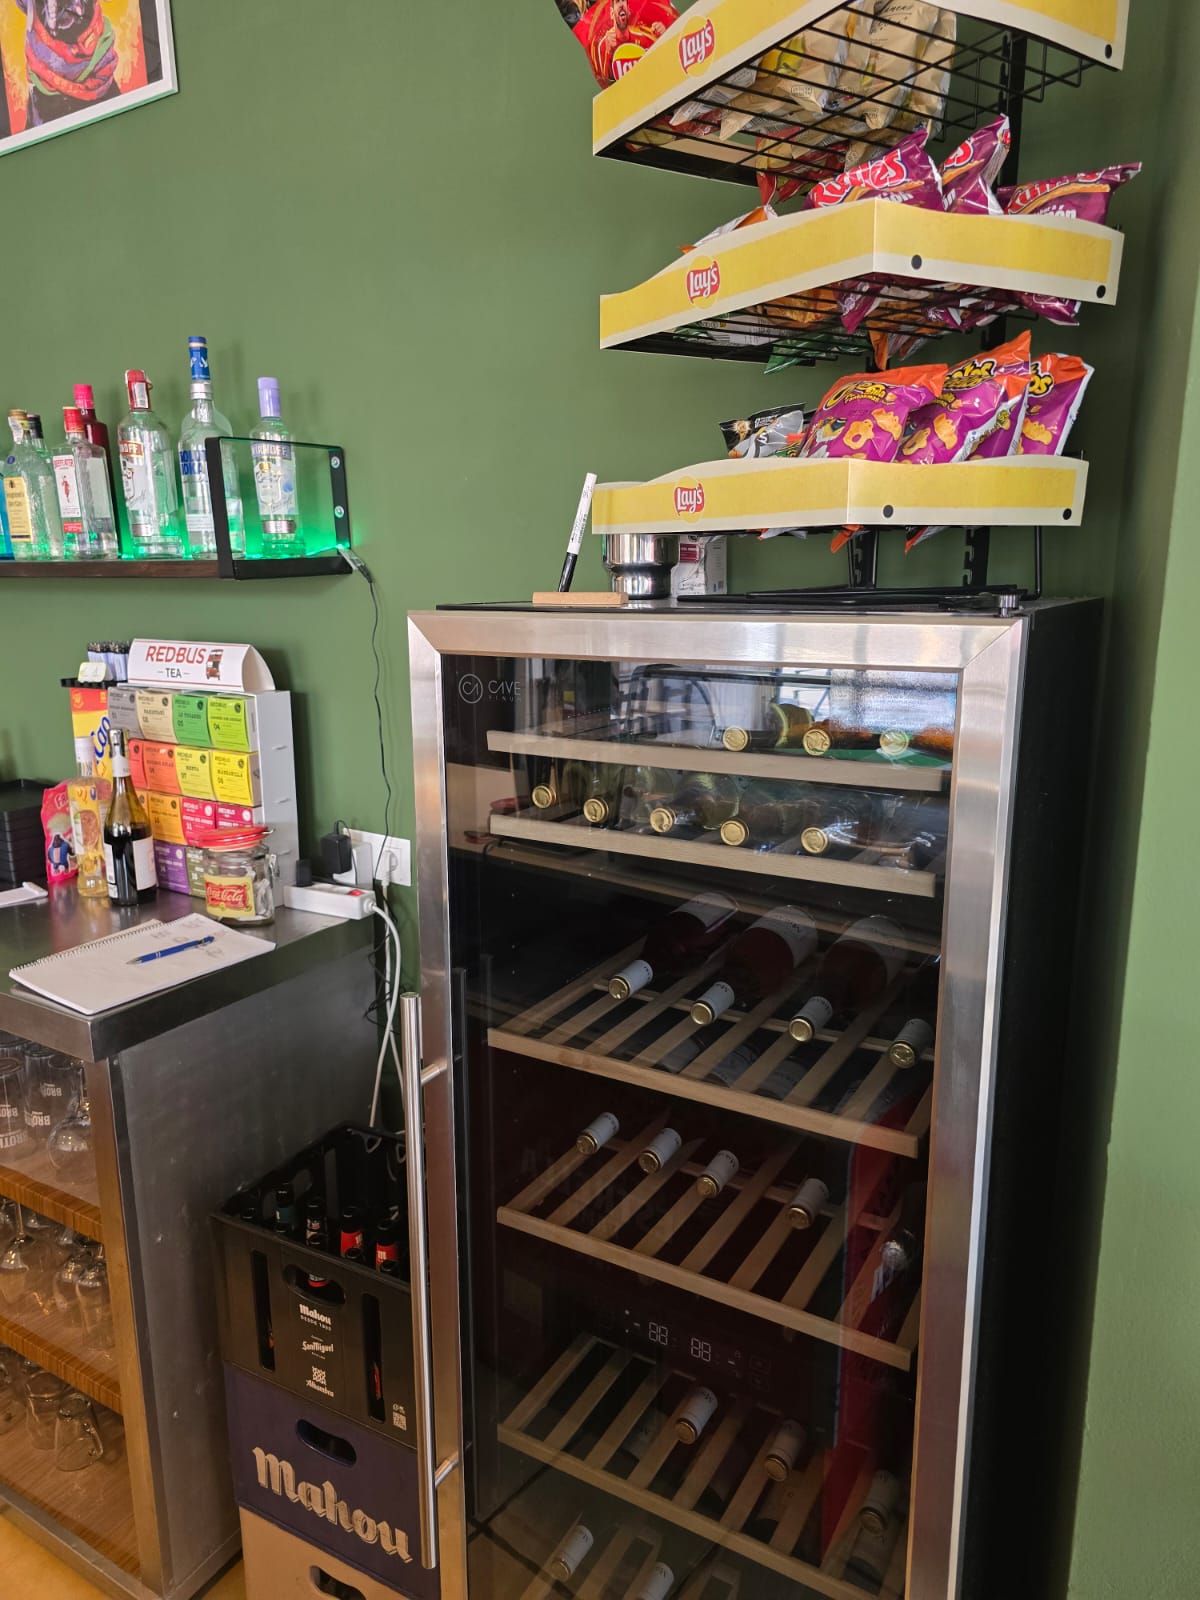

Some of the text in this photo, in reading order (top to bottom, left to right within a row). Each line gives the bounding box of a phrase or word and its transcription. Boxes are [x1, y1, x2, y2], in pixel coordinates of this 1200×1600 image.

[681, 25, 713, 67] Lay's
[688, 265, 718, 298] Lay's
[676, 485, 704, 514] Lay's
[145, 645, 207, 665] REDBUS
[165, 667, 182, 678] TEA
[488, 680, 521, 696] CAVE
[299, 1303, 332, 1326] Mahou
[252, 1447, 413, 1564] Mahou
